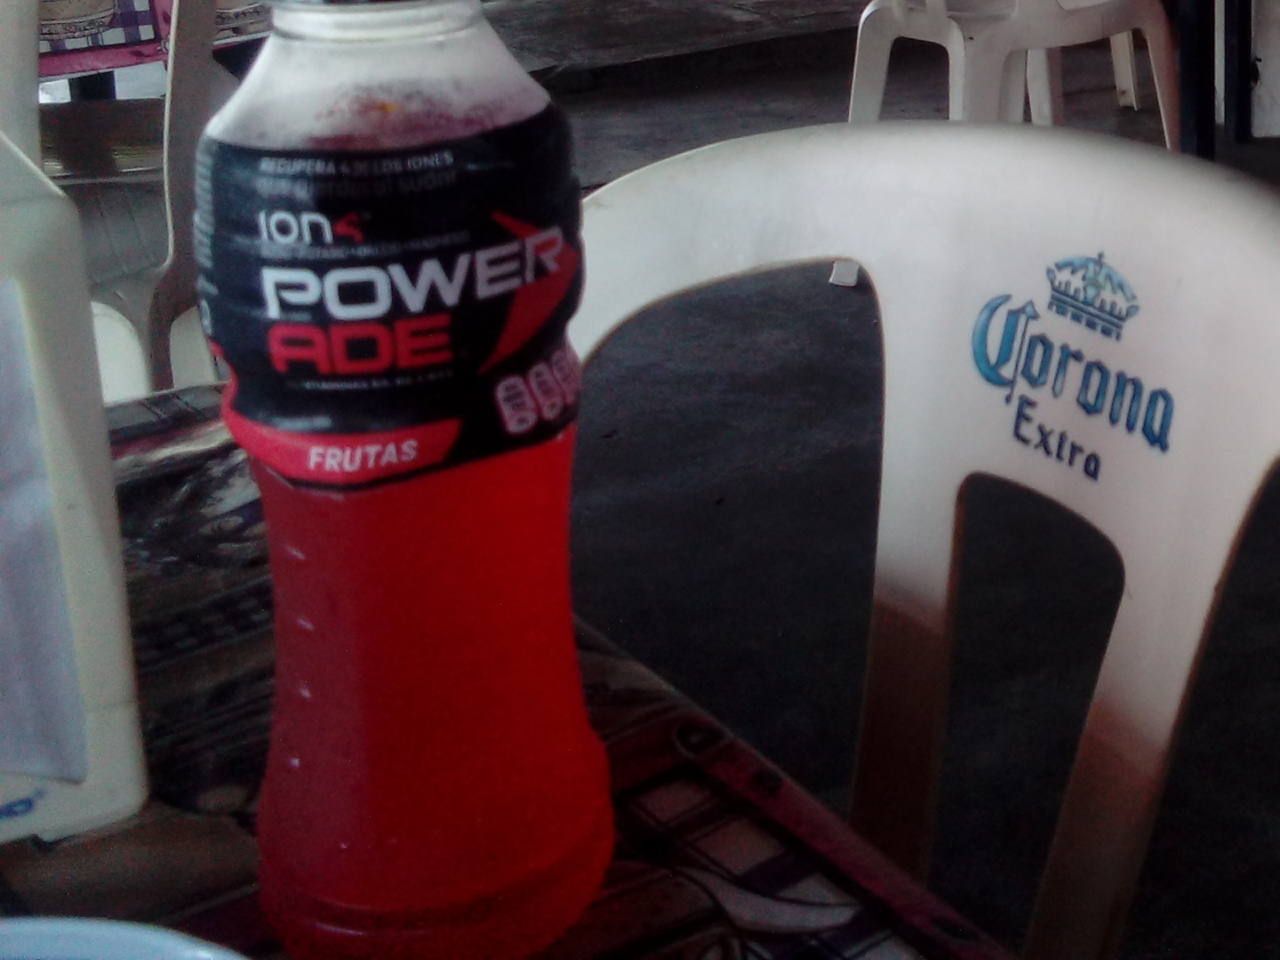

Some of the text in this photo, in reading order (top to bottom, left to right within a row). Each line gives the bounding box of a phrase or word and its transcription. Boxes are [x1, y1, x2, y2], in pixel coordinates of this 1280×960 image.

[261, 226, 564, 319] POWER
[268, 313, 455, 375] ADE
[972, 293, 1174, 453] Corona
[308, 439, 418, 472] FRUTAS
[1013, 394, 1101, 481] Extra
